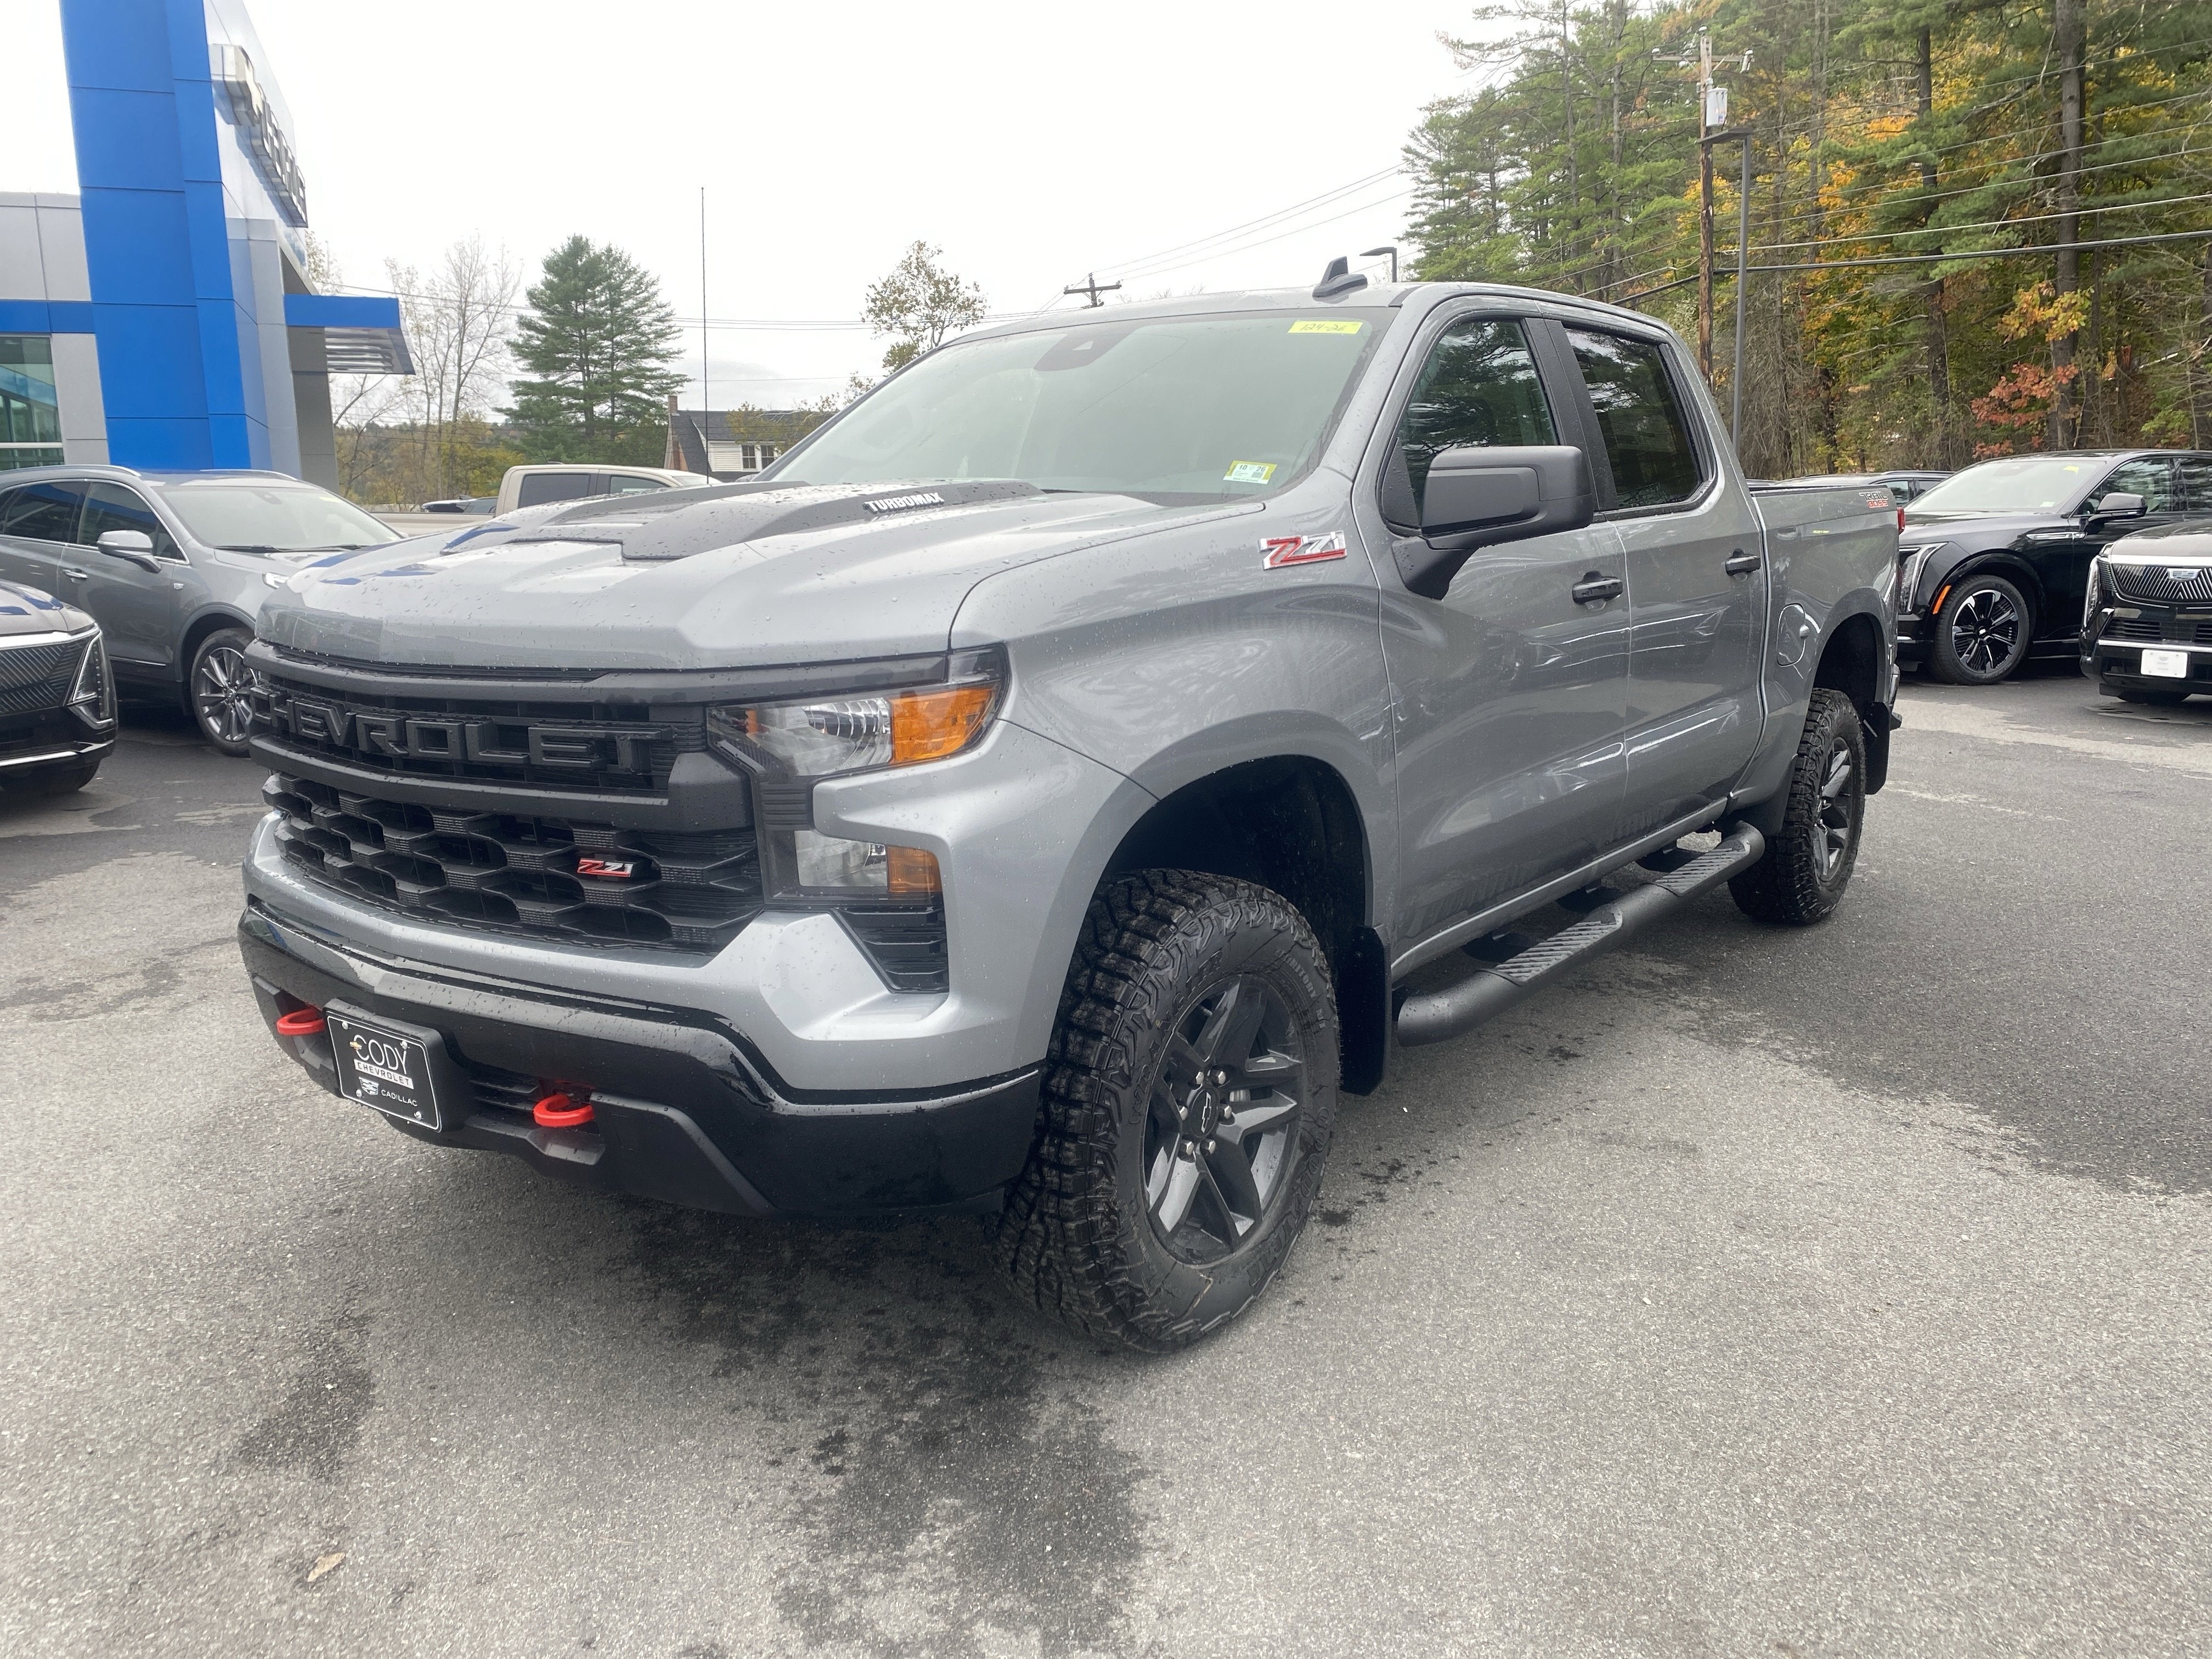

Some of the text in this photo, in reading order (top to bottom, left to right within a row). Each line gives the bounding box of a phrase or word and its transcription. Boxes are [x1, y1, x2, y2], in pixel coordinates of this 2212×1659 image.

[864, 492, 945, 515] TURBOMAX
[1859, 491, 1888, 501] TRAIL
[1867, 499, 1888, 509] BOSS
[1260, 530, 1347, 571] Z71
[250, 685, 671, 773] CHEVROLET
[577, 857, 634, 878] Z71
[351, 1034, 407, 1075] CODY
[357, 1061, 410, 1086] CHEVROLET
[381, 1090, 417, 1107] CADILLAC
